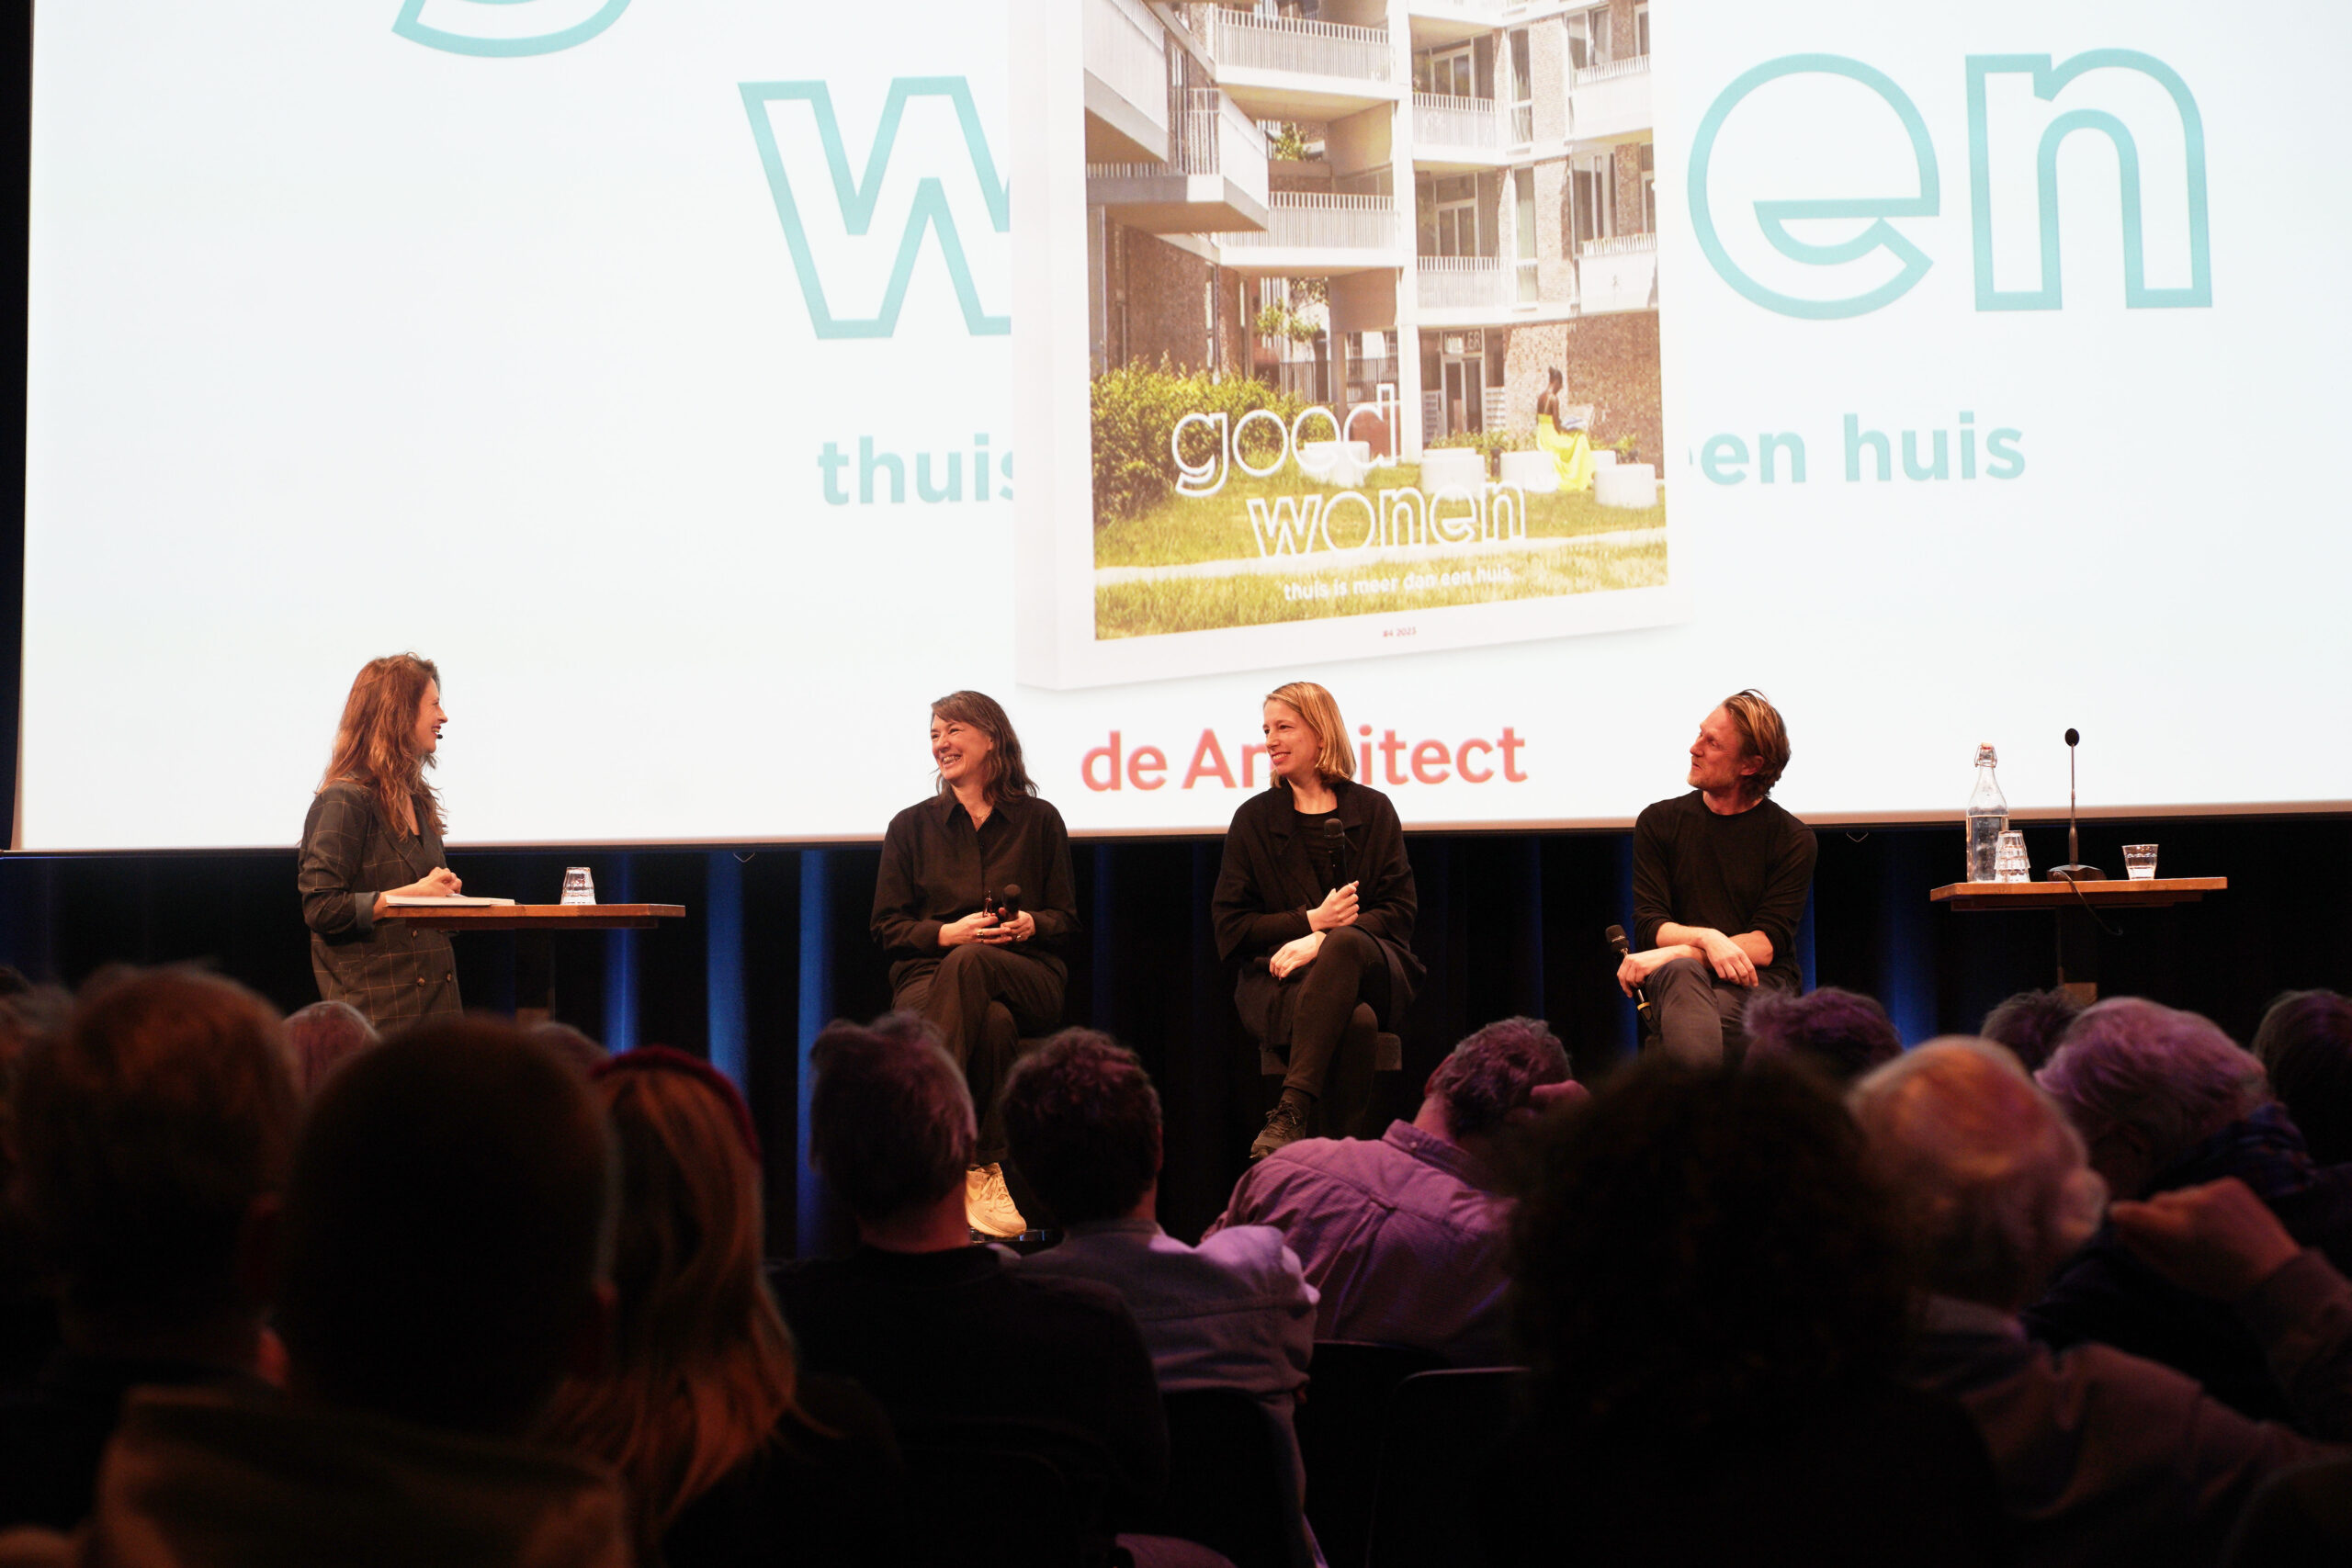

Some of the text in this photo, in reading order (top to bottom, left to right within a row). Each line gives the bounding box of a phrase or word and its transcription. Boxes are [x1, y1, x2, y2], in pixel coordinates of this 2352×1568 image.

[1170, 383, 1396, 498] goed
[1689, 432, 1807, 485] en
[1843, 410, 2027, 481] huis
[1246, 479, 1527, 558] wonen
[1283, 564, 1512, 601] thuis is meer dan een huis
[1081, 725, 1527, 792] de Aritect
